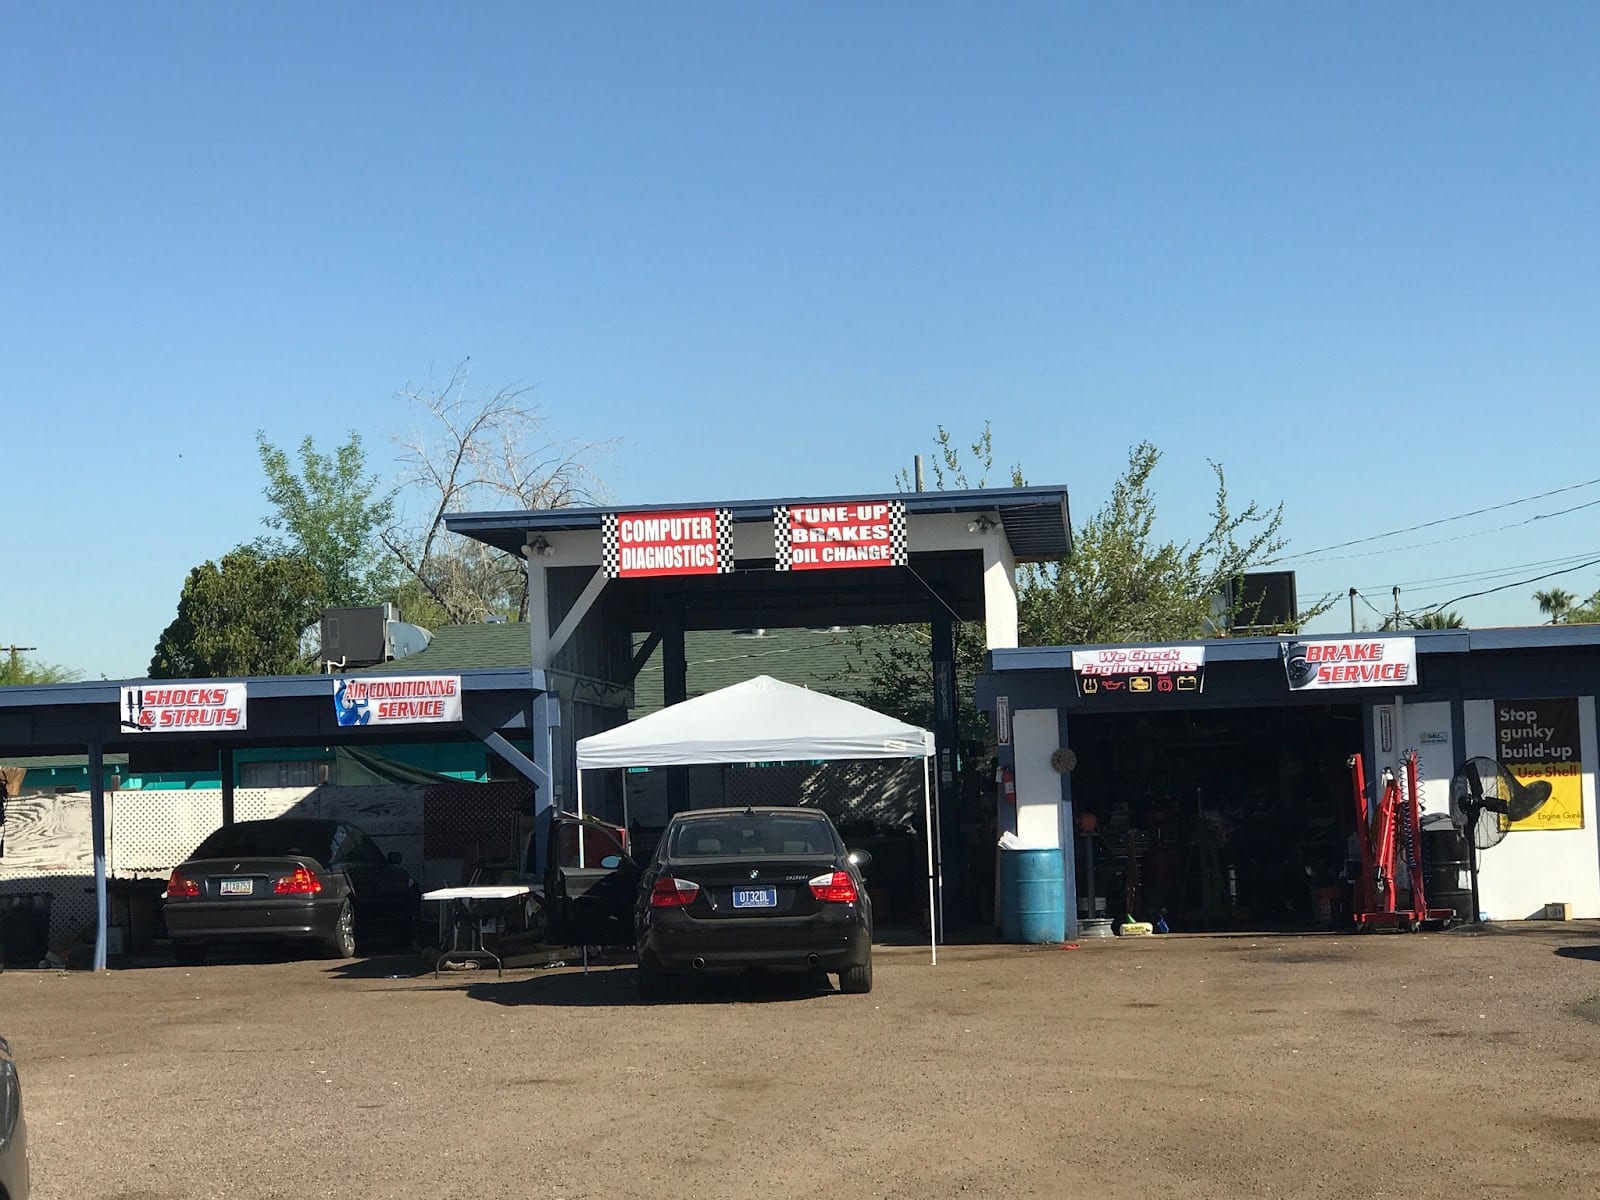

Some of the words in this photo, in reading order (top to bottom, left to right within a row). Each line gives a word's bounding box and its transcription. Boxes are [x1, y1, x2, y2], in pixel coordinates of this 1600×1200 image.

[790, 504, 888, 524] TUNE-UP
[620, 517, 713, 543] COMPUTER
[791, 523, 889, 543] BRAKES
[621, 543, 715, 570] DIAGNOSTICS
[792, 547, 820, 564] OIL
[822, 545, 890, 562] CHANGE
[1099, 651, 1126, 662] We
[1128, 649, 1180, 661] Check
[1305, 643, 1383, 662] BRAKE
[1080, 662, 1140, 676] Engine
[1142, 662, 1199, 675] Lights
[1317, 663, 1408, 682] SERVICE
[143, 689, 228, 707] SHOCKS
[344, 682, 367, 699] AIR
[368, 680, 456, 698] CONDITIONING
[138, 709, 157, 727] &
[159, 707, 240, 726] STRUTS
[377, 699, 445, 719] SERVICE
[1500, 708, 1538, 724] Stop
[1501, 723, 1555, 742] gunky
[1501, 743, 1573, 760] build-up
[1517, 767, 1543, 778] Use
[1544, 765, 1578, 778] Shell
[1537, 812, 1561, 821] Engine
